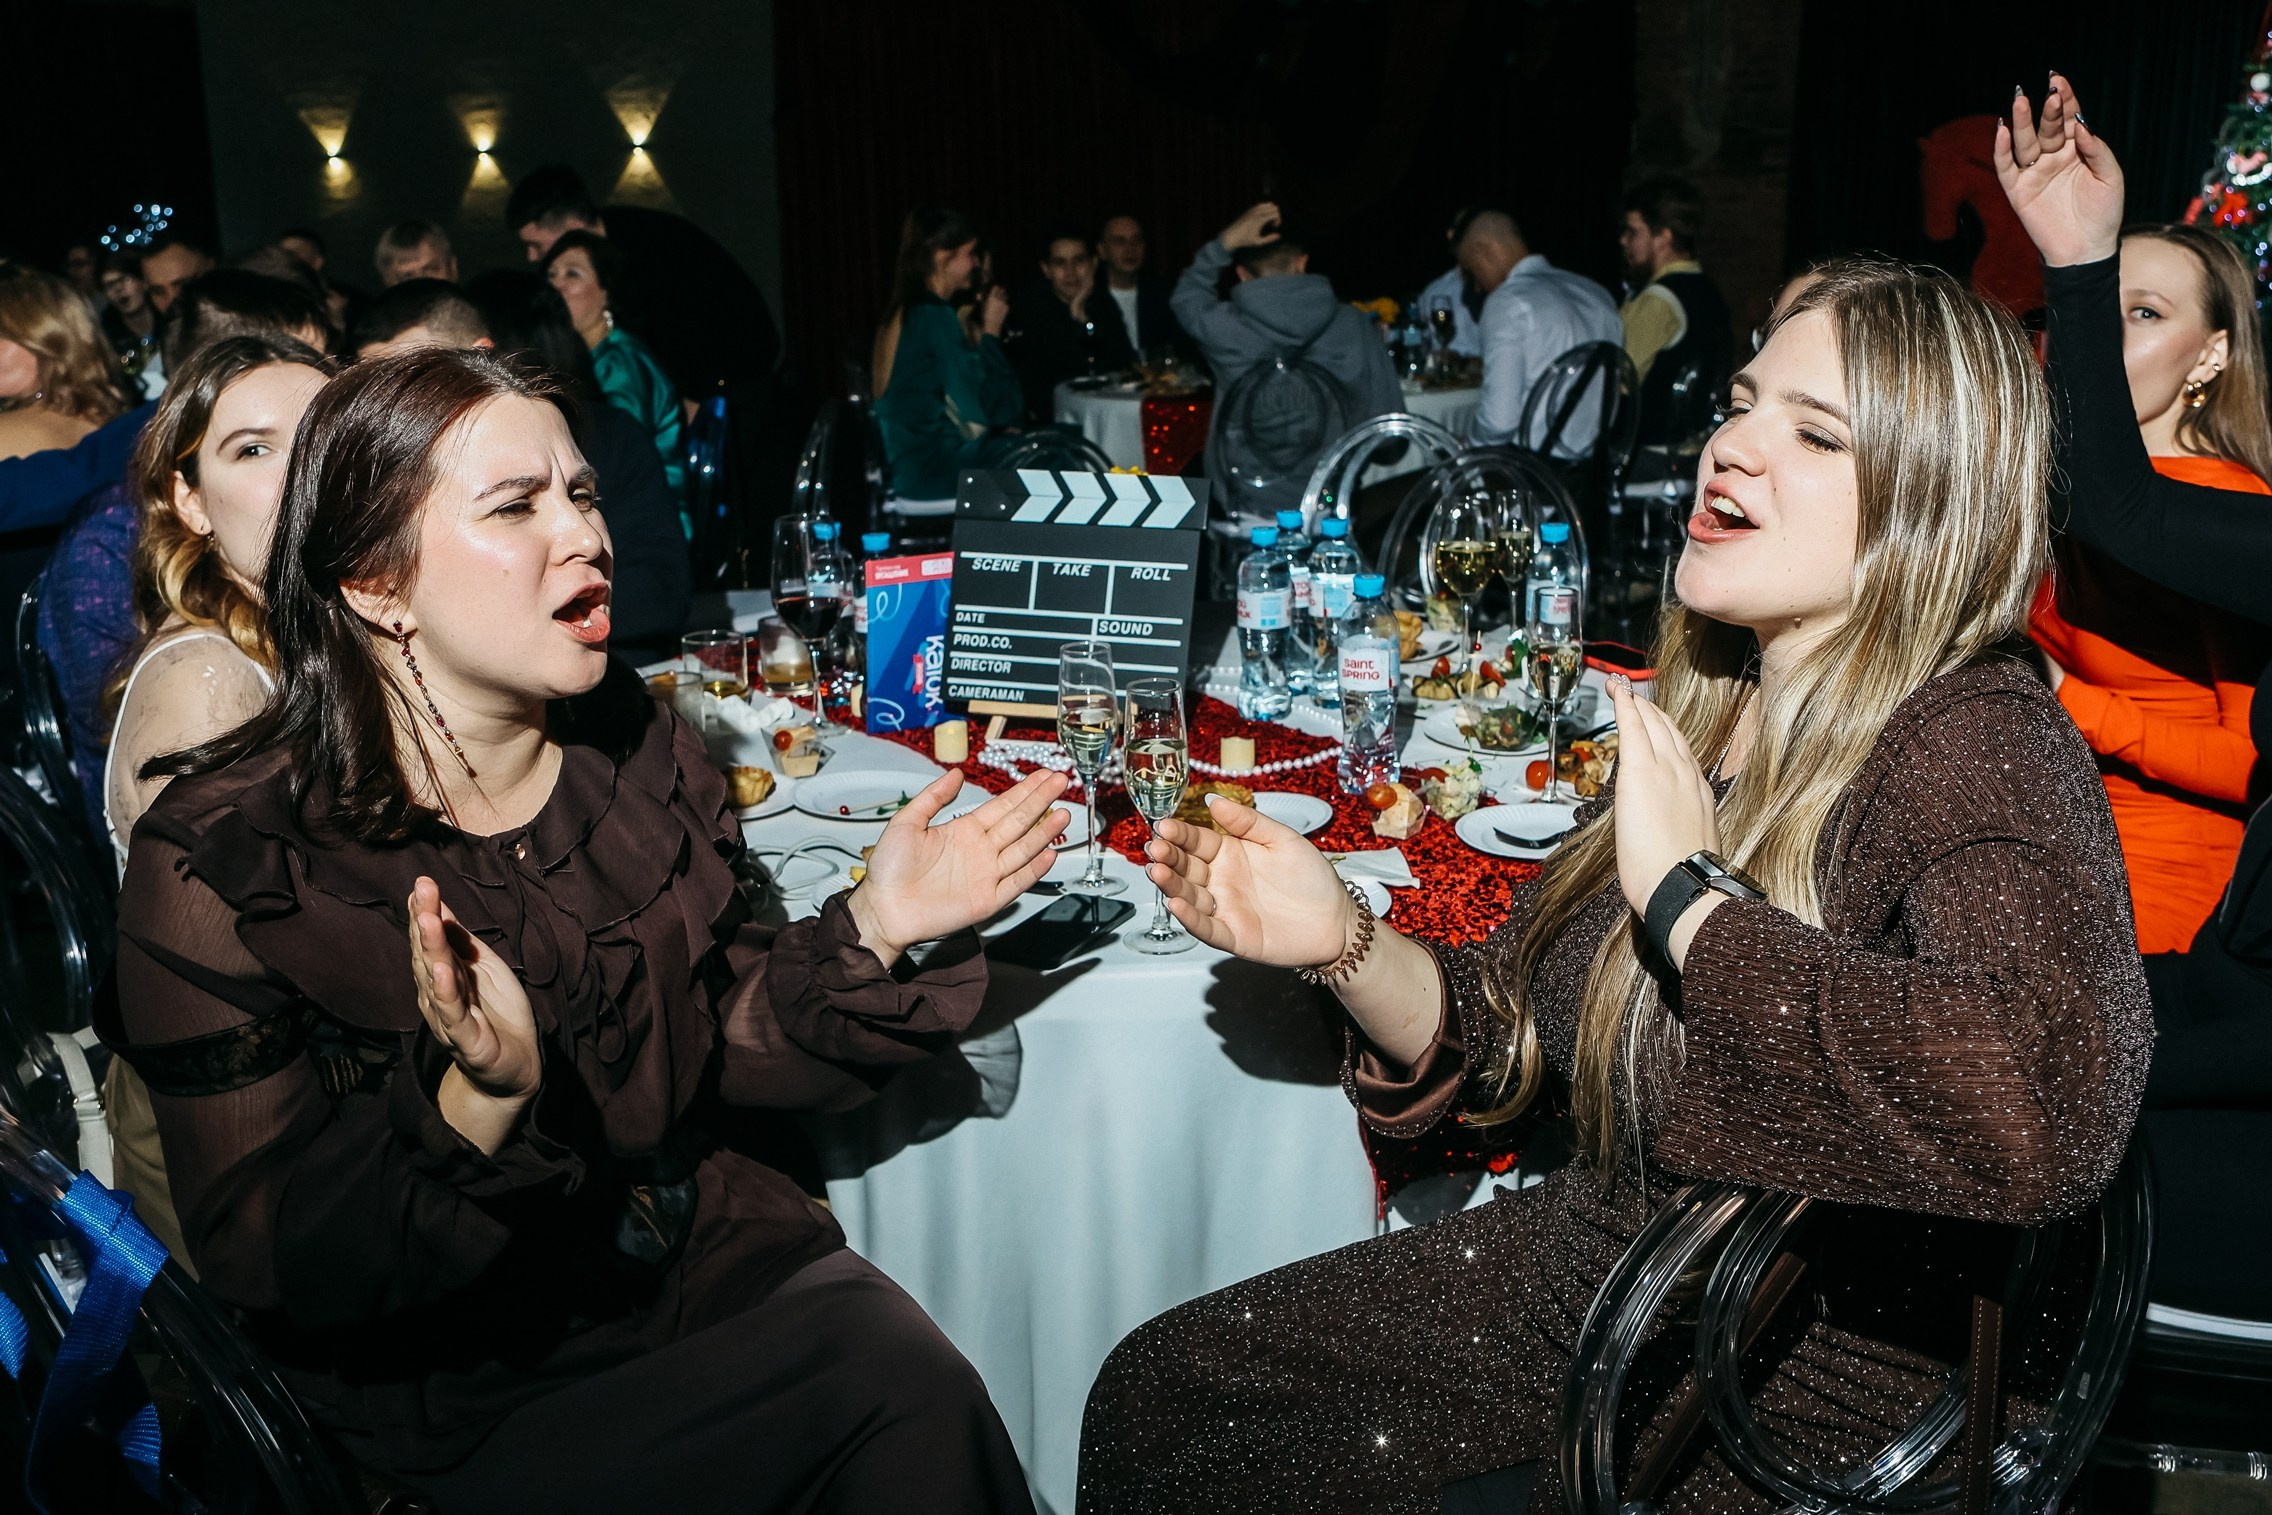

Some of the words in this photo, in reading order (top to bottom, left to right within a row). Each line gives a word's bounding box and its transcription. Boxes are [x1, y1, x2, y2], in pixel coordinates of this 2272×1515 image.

[971, 557, 1022, 573] SCENE
[1052, 563, 1092, 577] TAKE
[1130, 567, 1171, 581] ROLL
[955, 612, 986, 624] DATE
[1098, 620, 1153, 636] SOUND
[950, 657, 1012, 674] DIRECTOR
[948, 684, 1025, 702] CAMERAMAN
